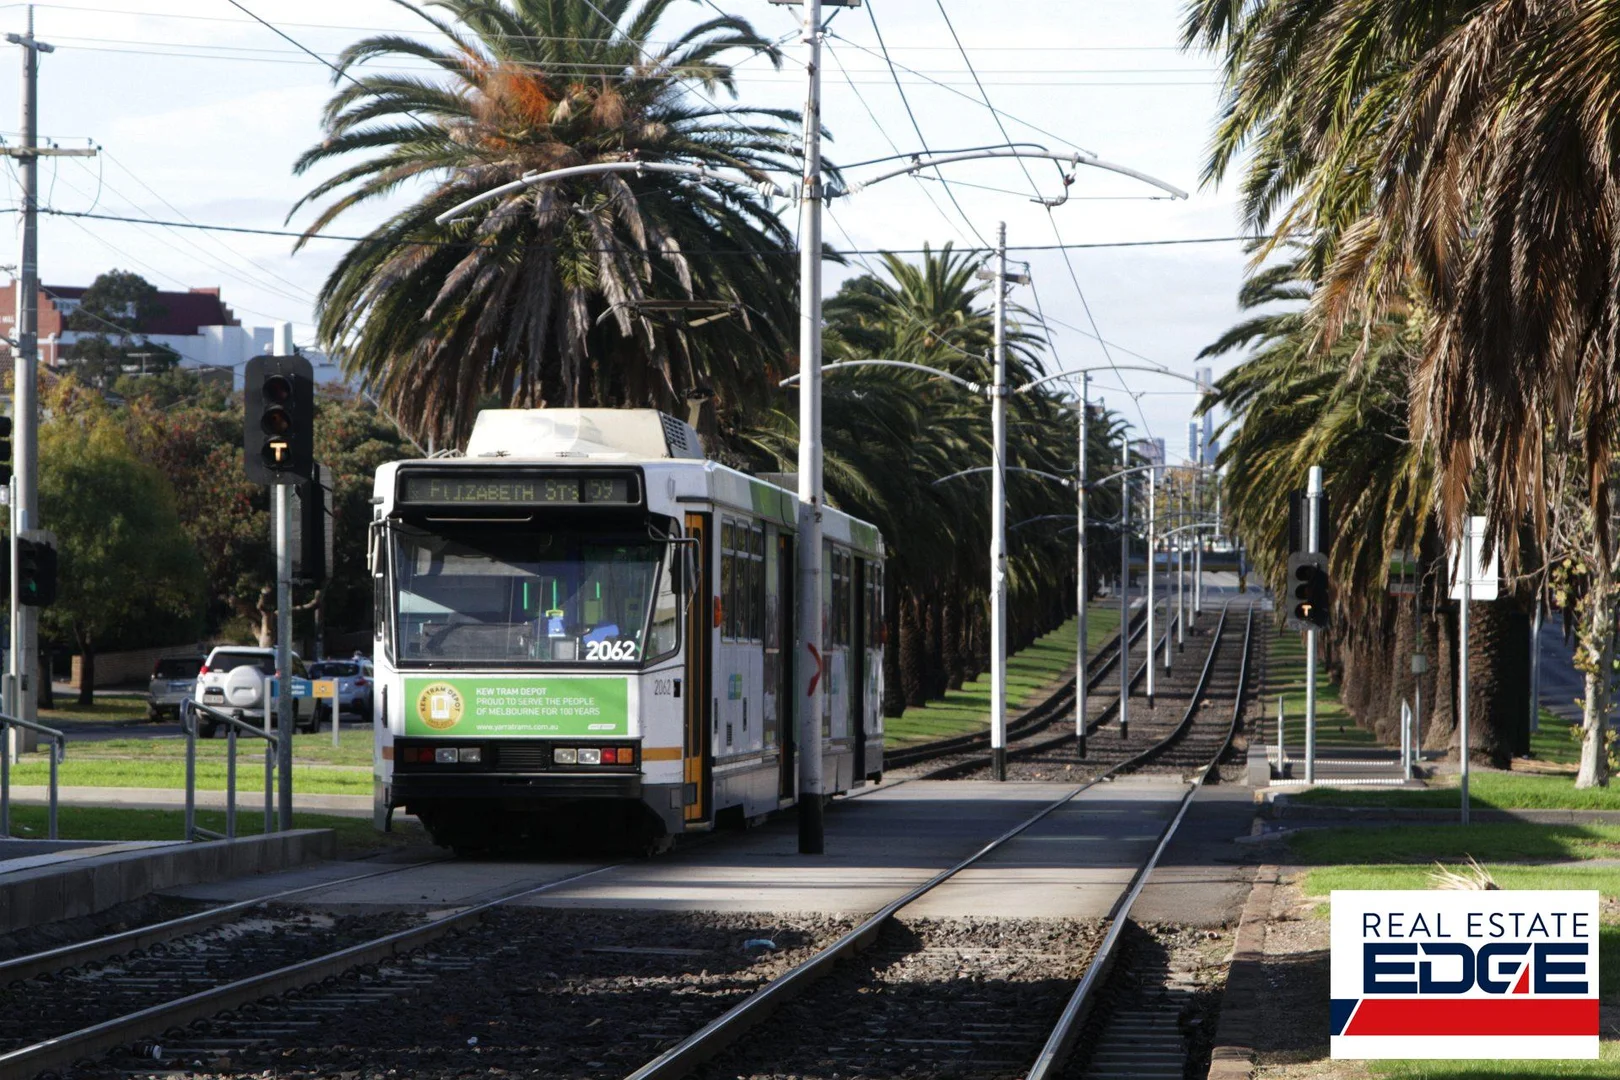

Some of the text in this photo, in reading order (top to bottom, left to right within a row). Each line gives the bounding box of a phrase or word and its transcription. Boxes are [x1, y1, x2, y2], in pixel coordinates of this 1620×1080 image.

[270, 442, 287, 461] T
[1301, 604, 1312, 617] T
[585, 640, 636, 661] 2062
[476, 687, 547, 696] KEW TRAM DEPOT
[654, 679, 671, 696] 2062
[476, 697, 595, 705] PROUD TO SERVE THE PEOPLE
[476, 707, 601, 716] OF MELBOURNE FOR 100 YEARS
[476, 723, 559, 731] www.yarratrams.com.au
